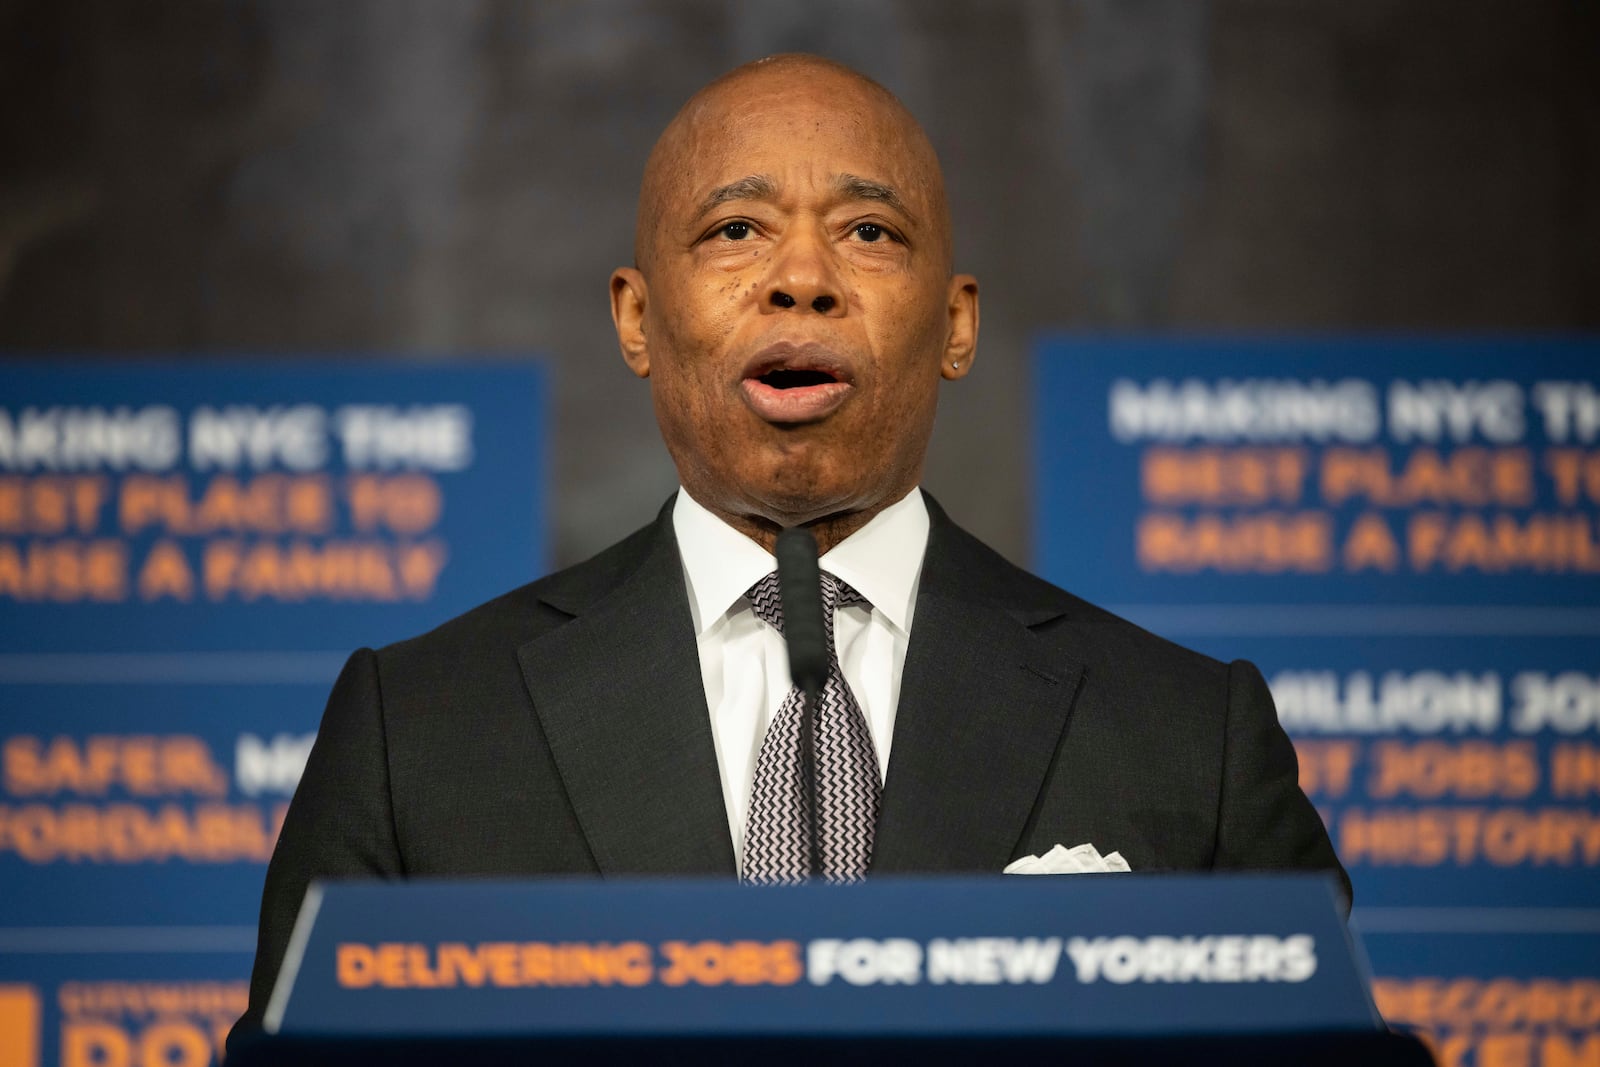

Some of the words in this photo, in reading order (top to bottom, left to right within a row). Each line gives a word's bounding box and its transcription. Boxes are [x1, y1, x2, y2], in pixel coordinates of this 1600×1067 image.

[190, 407, 326, 472] NYC
[338, 406, 470, 472] THE
[1109, 381, 1379, 442] MAKING
[1388, 382, 1523, 442] NYC
[120, 474, 332, 534] PLACE
[347, 474, 441, 535] TO
[1141, 447, 1305, 506] BEST
[1320, 447, 1530, 506] PLACE
[141, 541, 193, 599] A
[204, 541, 444, 600] FAMILY
[1137, 511, 1330, 571] RAISE
[1343, 513, 1397, 571] A
[1511, 672, 1600, 733] JO
[4, 736, 228, 798] SAFER,
[1370, 741, 1538, 797] JOBS
[336, 941, 654, 988] DELIVERING
[659, 940, 803, 987] JOBS
[807, 938, 923, 986] FOR
[927, 937, 1063, 985] NEW
[1066, 935, 1317, 984] YORKERS
